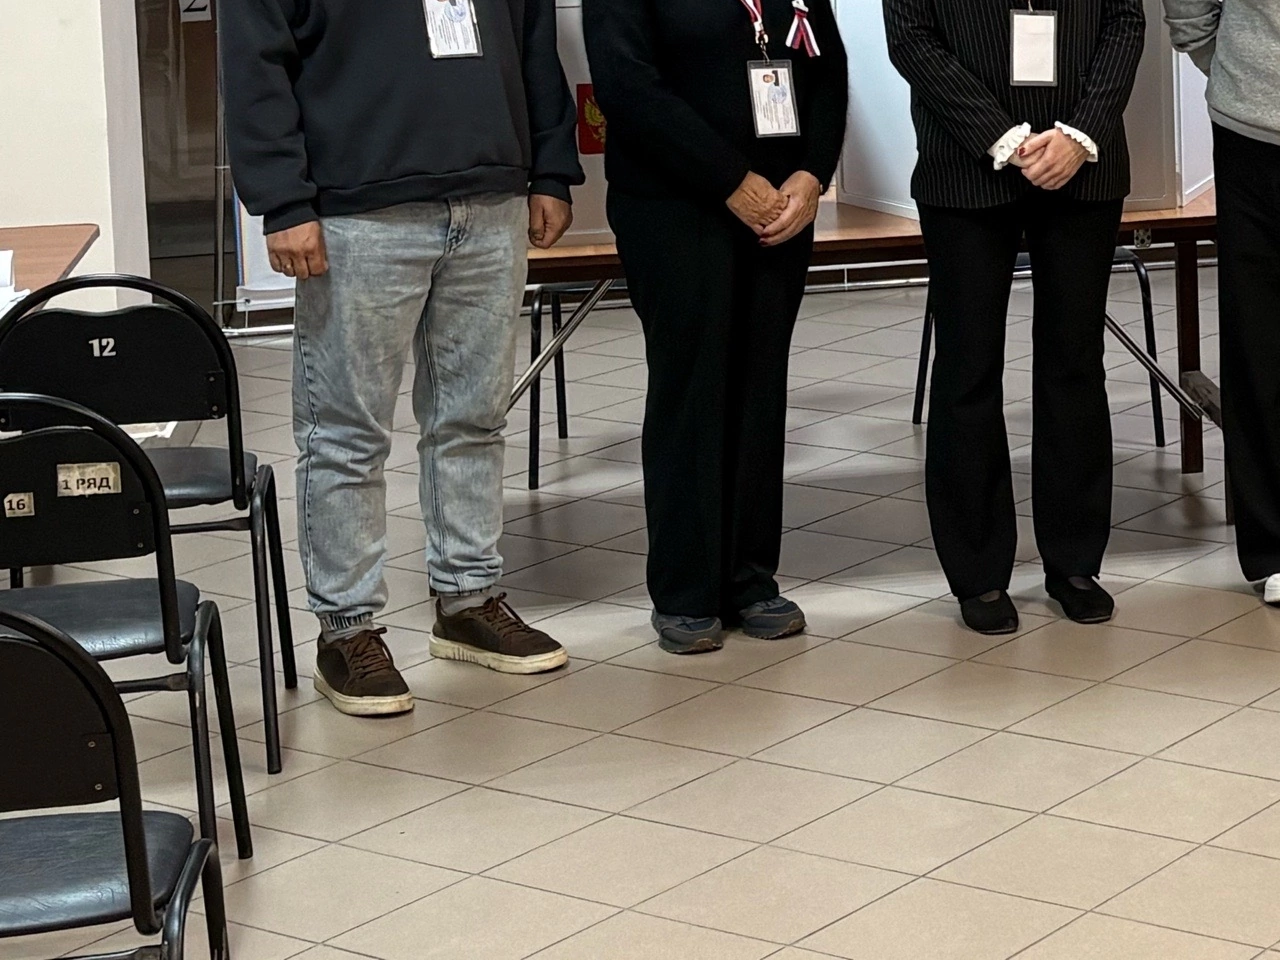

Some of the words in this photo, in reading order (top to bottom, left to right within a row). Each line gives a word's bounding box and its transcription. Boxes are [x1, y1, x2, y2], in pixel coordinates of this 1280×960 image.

[88, 337, 117, 357] 12
[61, 480, 72, 490] 1
[76, 477, 111, 491] РЯД
[6, 499, 26, 511] 16
